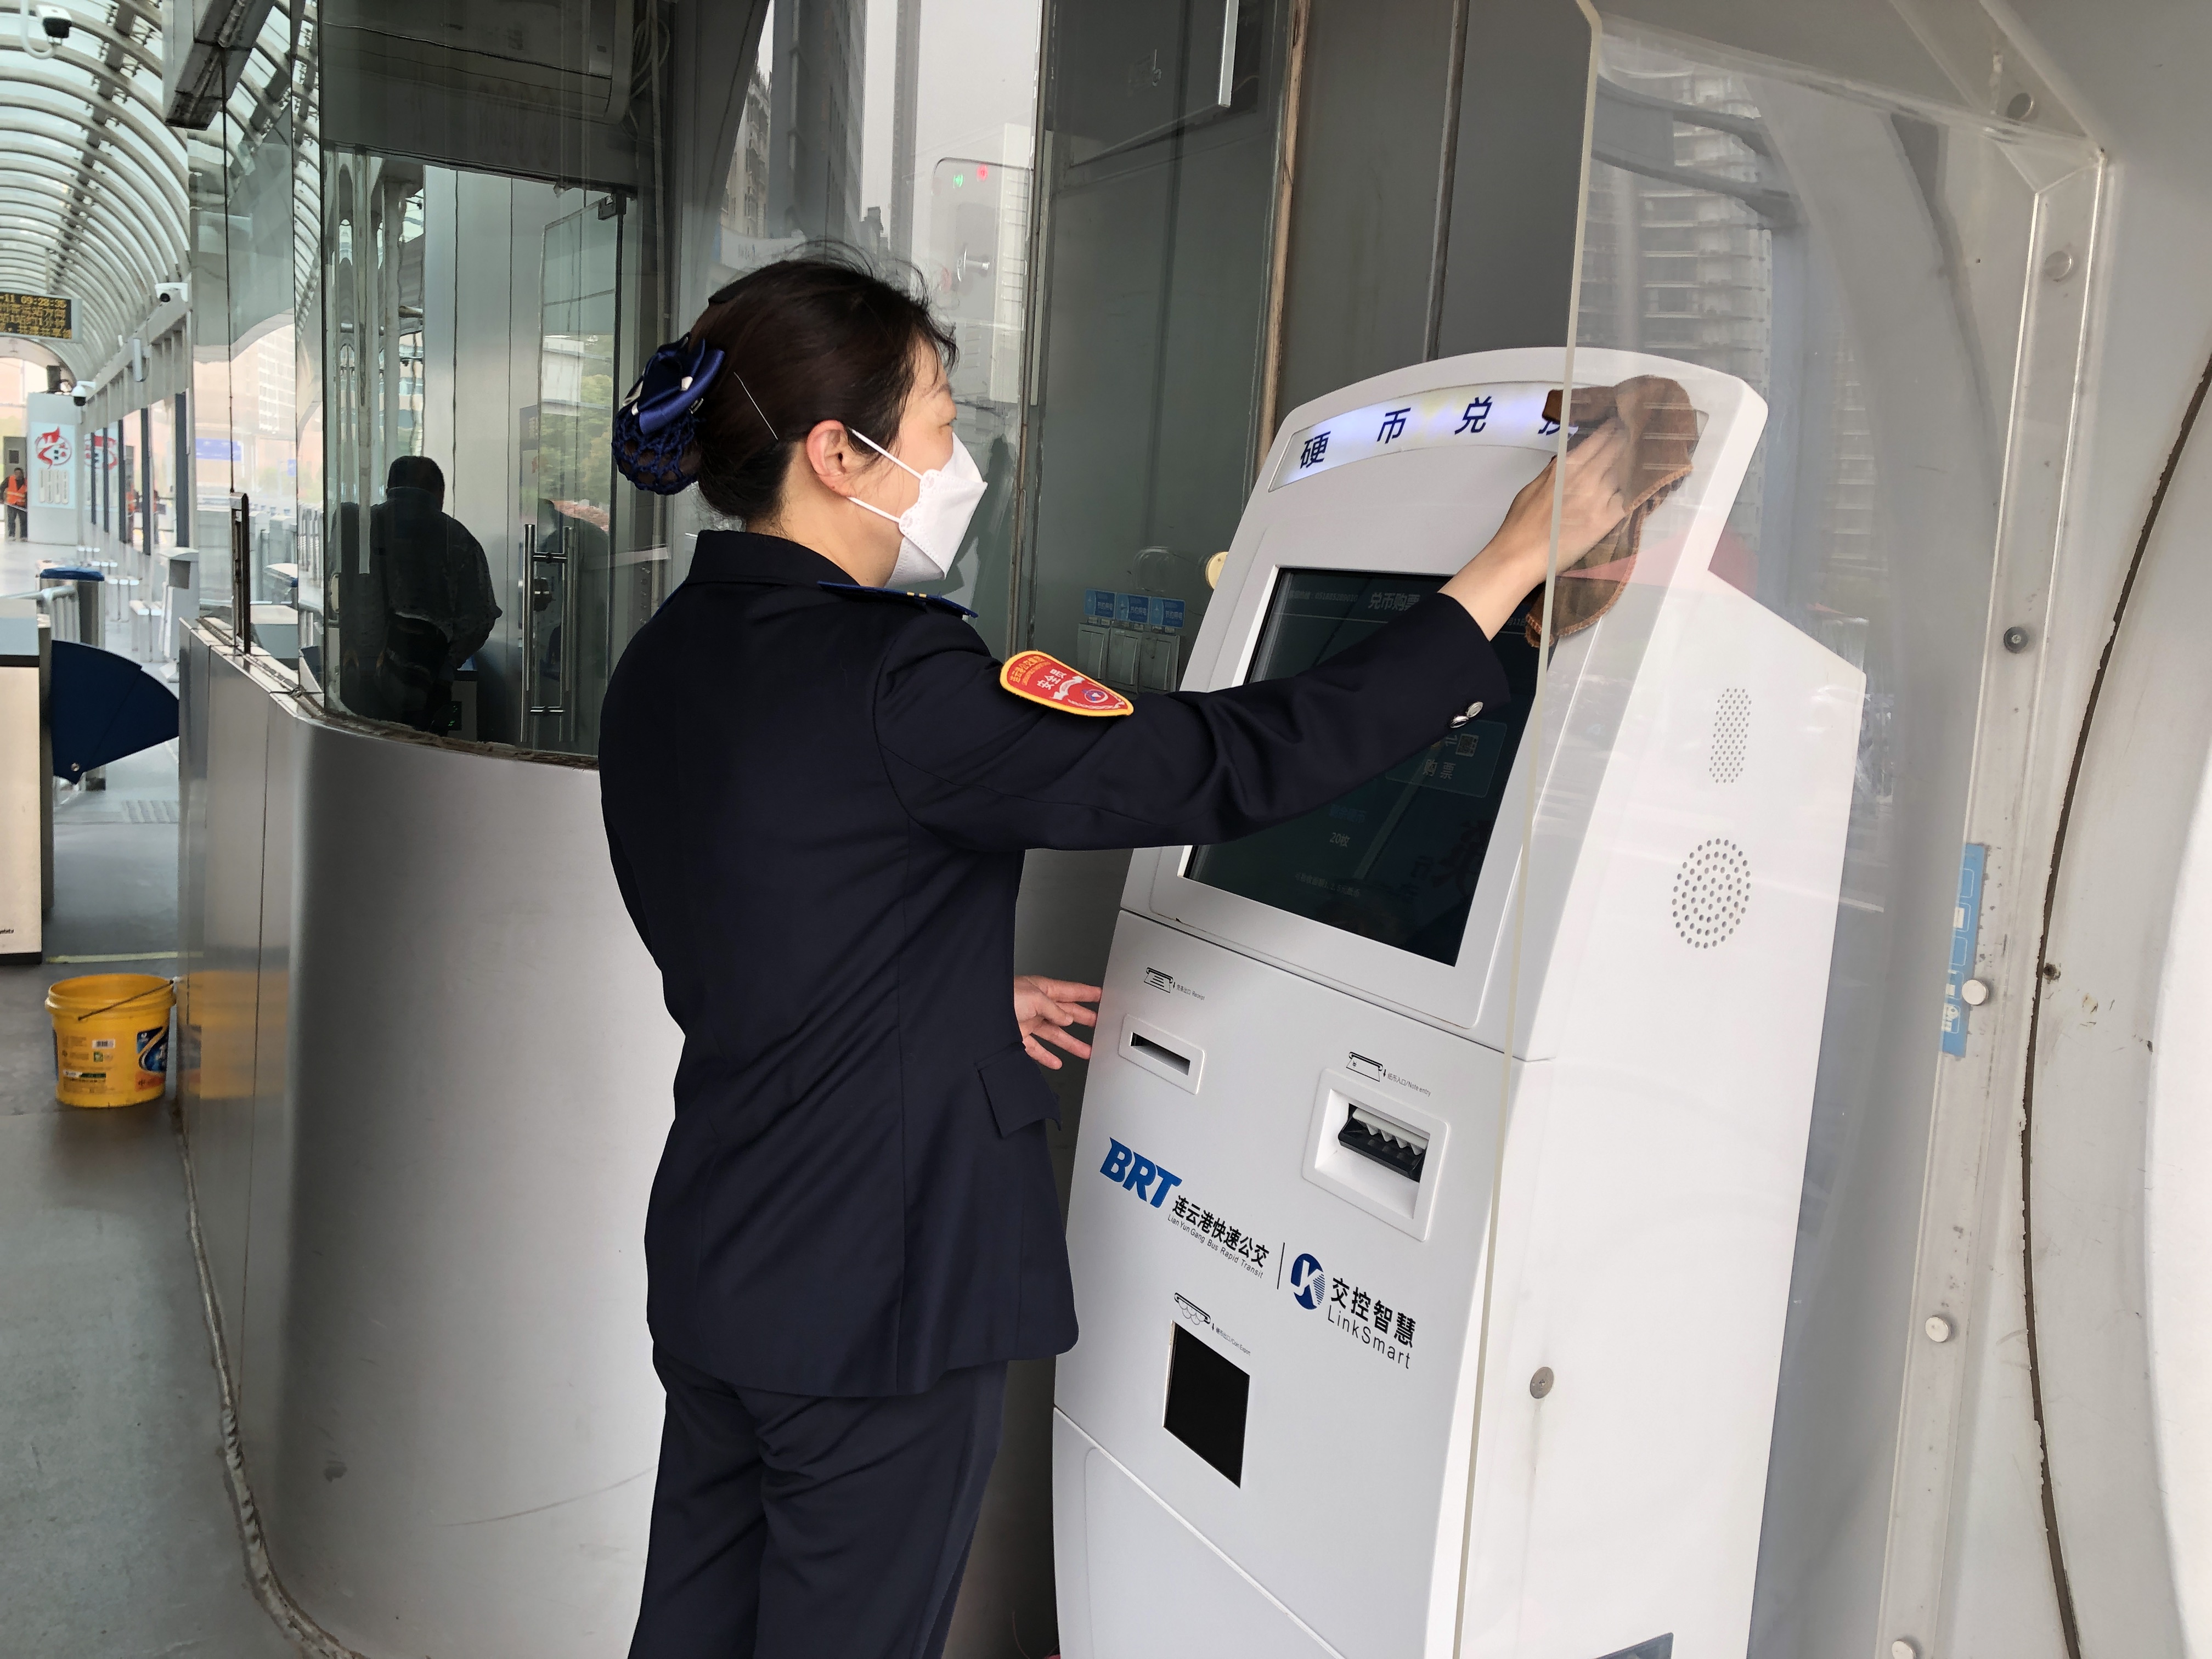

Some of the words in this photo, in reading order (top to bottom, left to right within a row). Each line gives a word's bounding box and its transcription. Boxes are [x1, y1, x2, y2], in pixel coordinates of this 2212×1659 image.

[1037, 668, 1068, 690] 安全员
[1329, 832, 1351, 848] 20枚
[1419, 1087, 1431, 1097] entry
[1099, 1136, 1183, 1209] BRT
[1167, 1214, 1180, 1227] Lian
[1180, 1221, 1190, 1234] Yun
[1190, 1228, 1206, 1244] Gang
[1207, 1238, 1219, 1251] Bus
[1220, 1246, 1239, 1264] Rapid
[1240, 1259, 1264, 1279] Transit
[1172, 1194, 1270, 1268] 连云港快速公交
[1327, 1304, 1411, 1370] LinkSmart
[1330, 1277, 1417, 1348] 交控智慧
